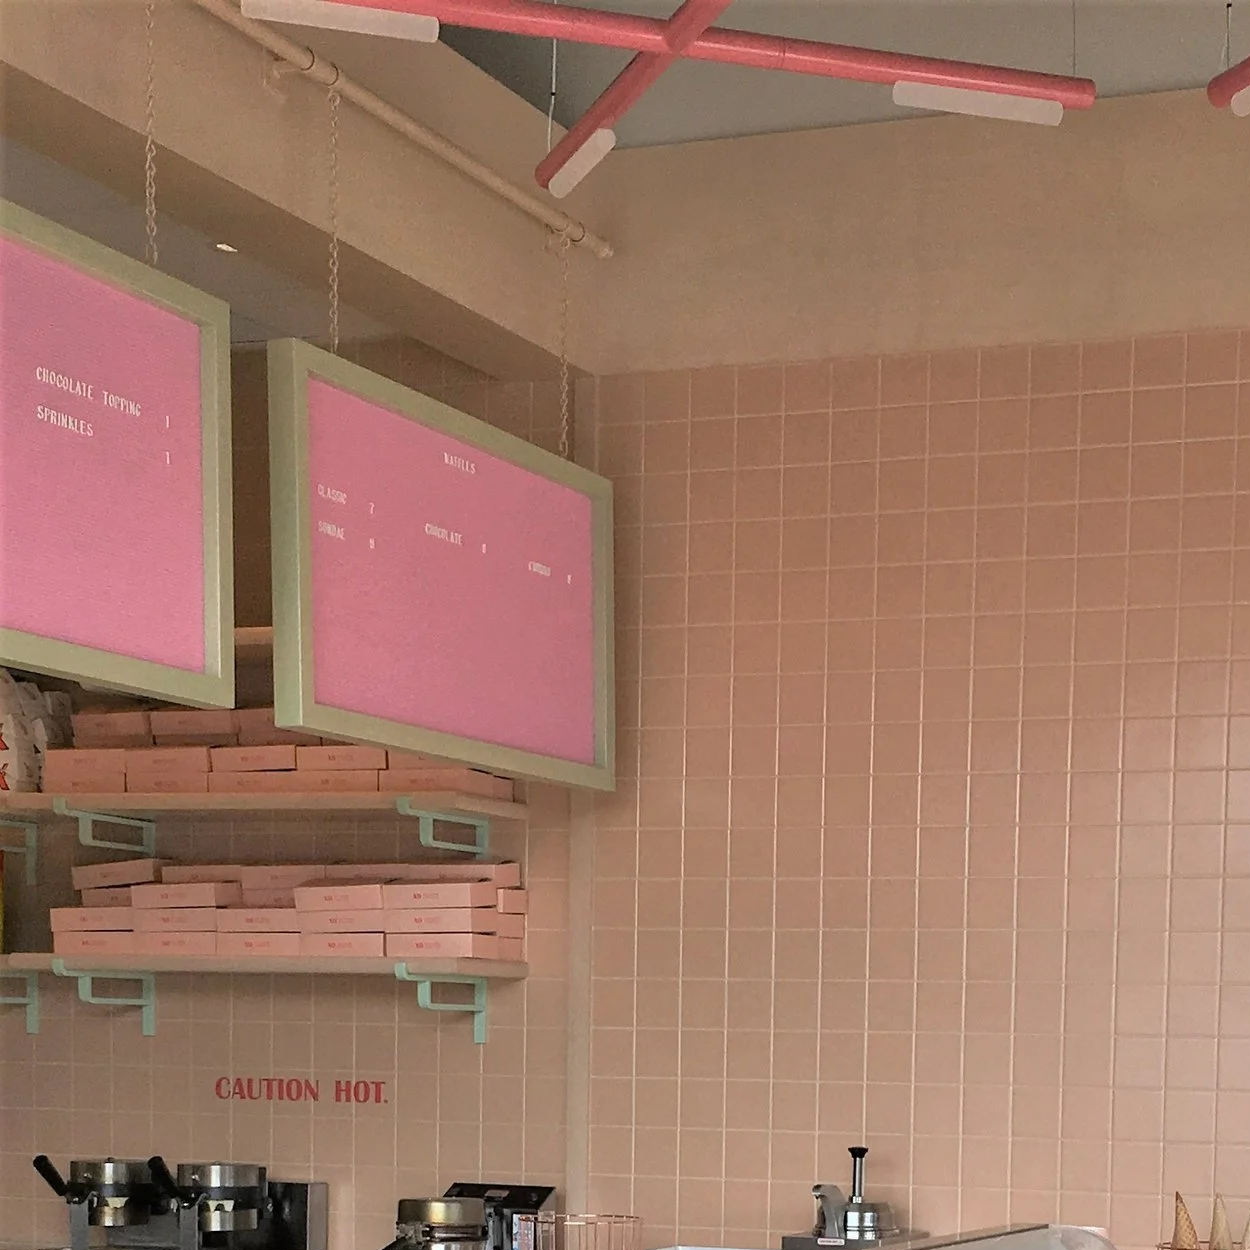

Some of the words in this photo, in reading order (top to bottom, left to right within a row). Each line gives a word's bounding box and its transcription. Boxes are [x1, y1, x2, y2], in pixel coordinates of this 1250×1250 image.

[36, 366, 94, 400] CHOCOLATE
[102, 390, 142, 417] TOPPING
[165, 415, 170, 428] 1
[37, 405, 94, 437] SPRINKLES
[165, 451, 170, 465] 1
[215, 1076, 319, 1102] CAUTION
[334, 1080, 388, 1104] HOT.
